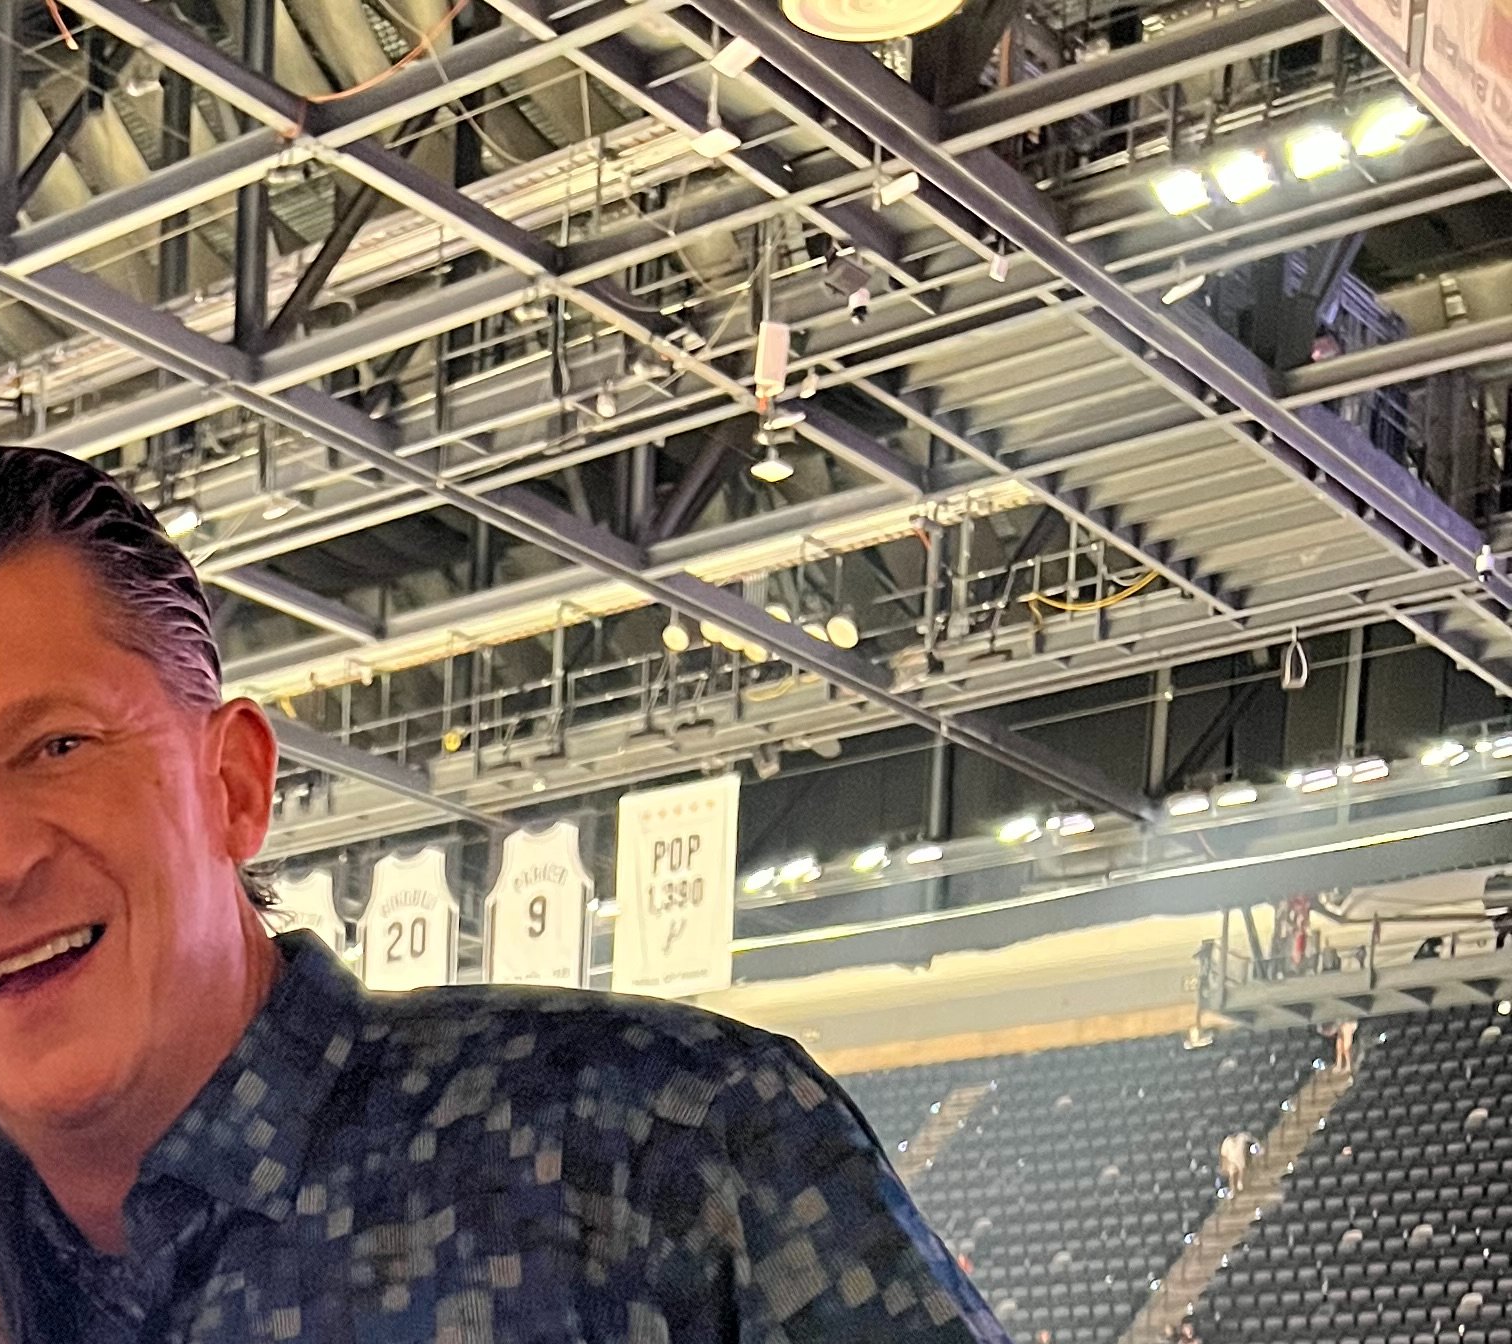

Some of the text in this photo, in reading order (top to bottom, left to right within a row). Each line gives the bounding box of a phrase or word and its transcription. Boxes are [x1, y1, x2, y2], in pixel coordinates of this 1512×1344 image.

[653, 834, 702, 875] POP
[527, 895, 548, 938] 9
[386, 916, 427, 964] 20
